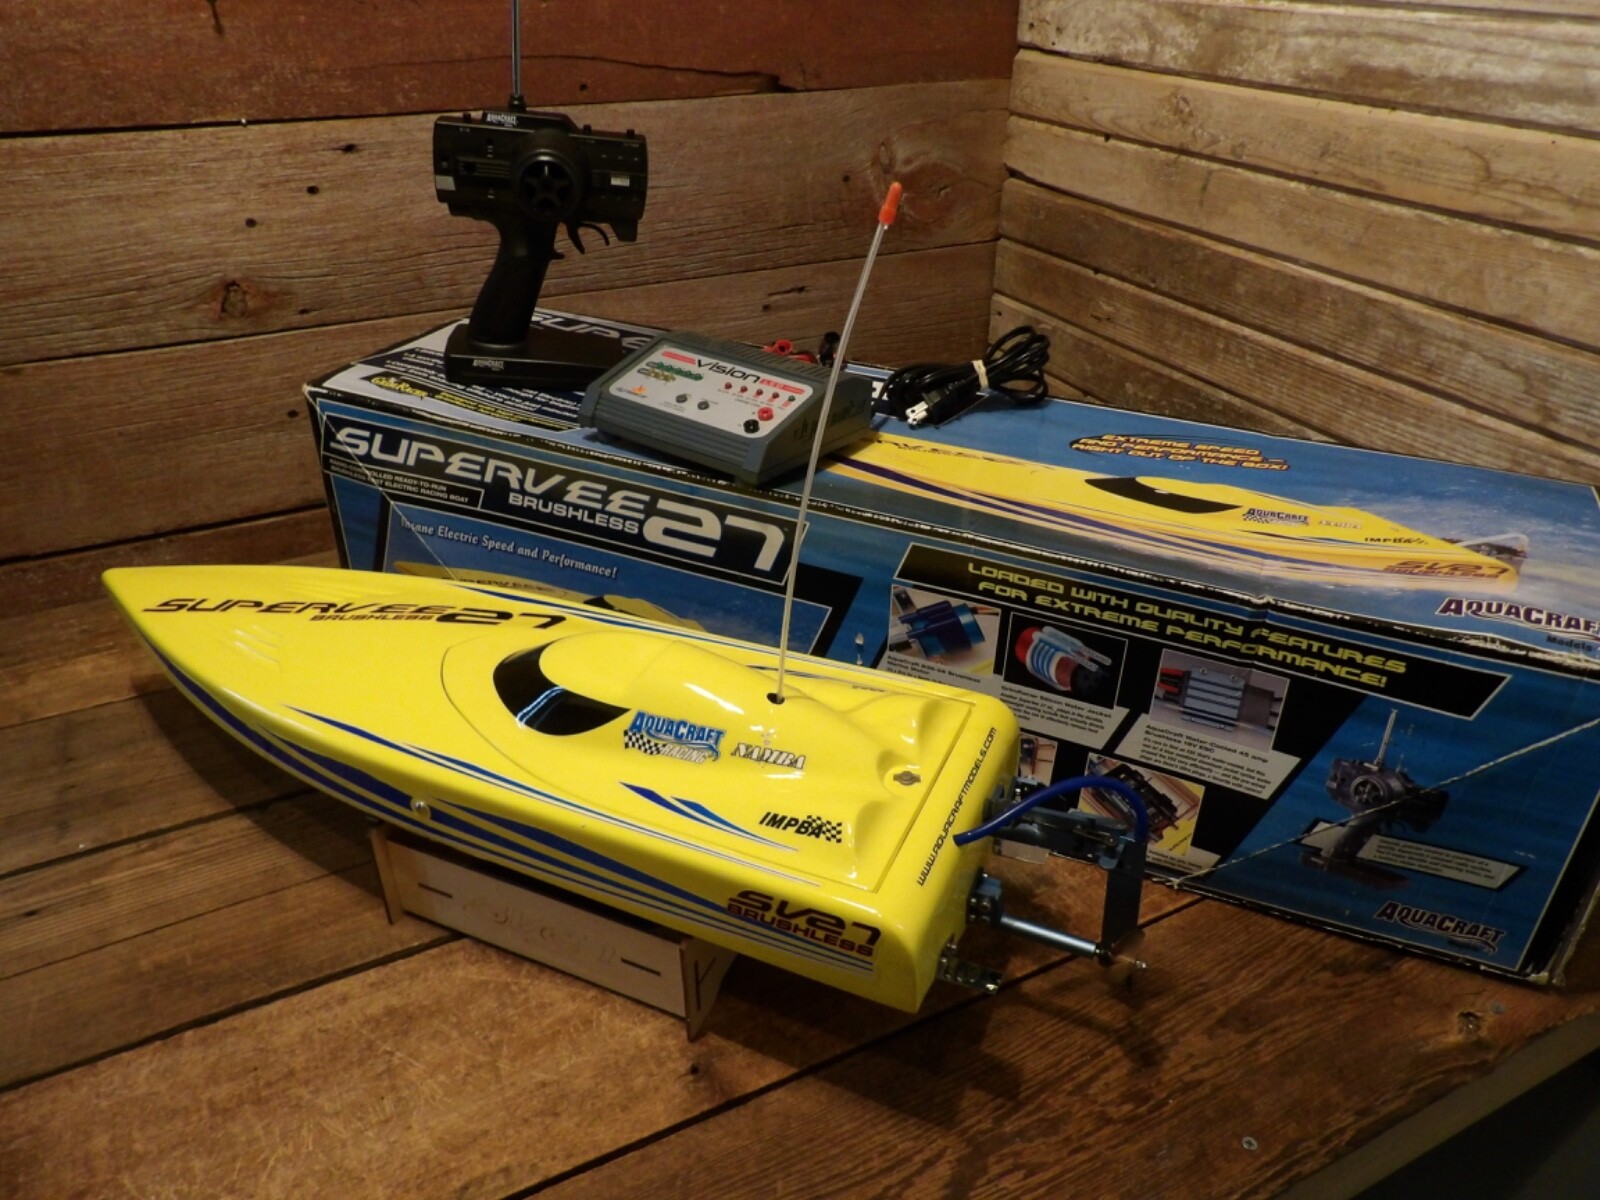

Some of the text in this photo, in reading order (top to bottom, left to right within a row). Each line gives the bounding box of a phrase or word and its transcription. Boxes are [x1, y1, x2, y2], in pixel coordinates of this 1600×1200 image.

[1071, 443, 1289, 471] RIGHT OUT OF THE BOX!
[1079, 438, 1263, 462] AND PERFORMANCE
[1101, 435, 1261, 455] EXTREME SPEED
[329, 458, 447, 492] RADIO-CONOLLED READY-TO-RUN
[385, 480, 419, 494] ELECTRIC
[420, 487, 448, 500] RACING
[449, 493, 469, 503] BOAT
[330, 427, 785, 572] SUPERVEE 27
[508, 492, 640, 534] BRUSHLESS
[438, 524, 478, 544] Electric
[482, 534, 514, 556] Speed
[518, 544, 539, 559] and
[542, 549, 618, 579] Performance!
[143, 598, 567, 630] SUPERVEE 27
[310, 614, 437, 622] BRUSHLESS
[968, 561, 1407, 674] LOADED WITH QUALITY FEATURES
[1435, 597, 1600, 632] AQUACRAF
[978, 581, 1387, 688] FOR EXTREME PERFORMANCE!
[629, 710, 726, 746] AQUACRAFT
[660, 744, 710, 764] RACING
[731, 743, 806, 770] NAMBA
[759, 812, 823, 838] IMPBA
[727, 904, 873, 958] BRUSHLESS
[728, 889, 881, 946] SV27
[1374, 901, 1506, 944] AQUACRAFT
